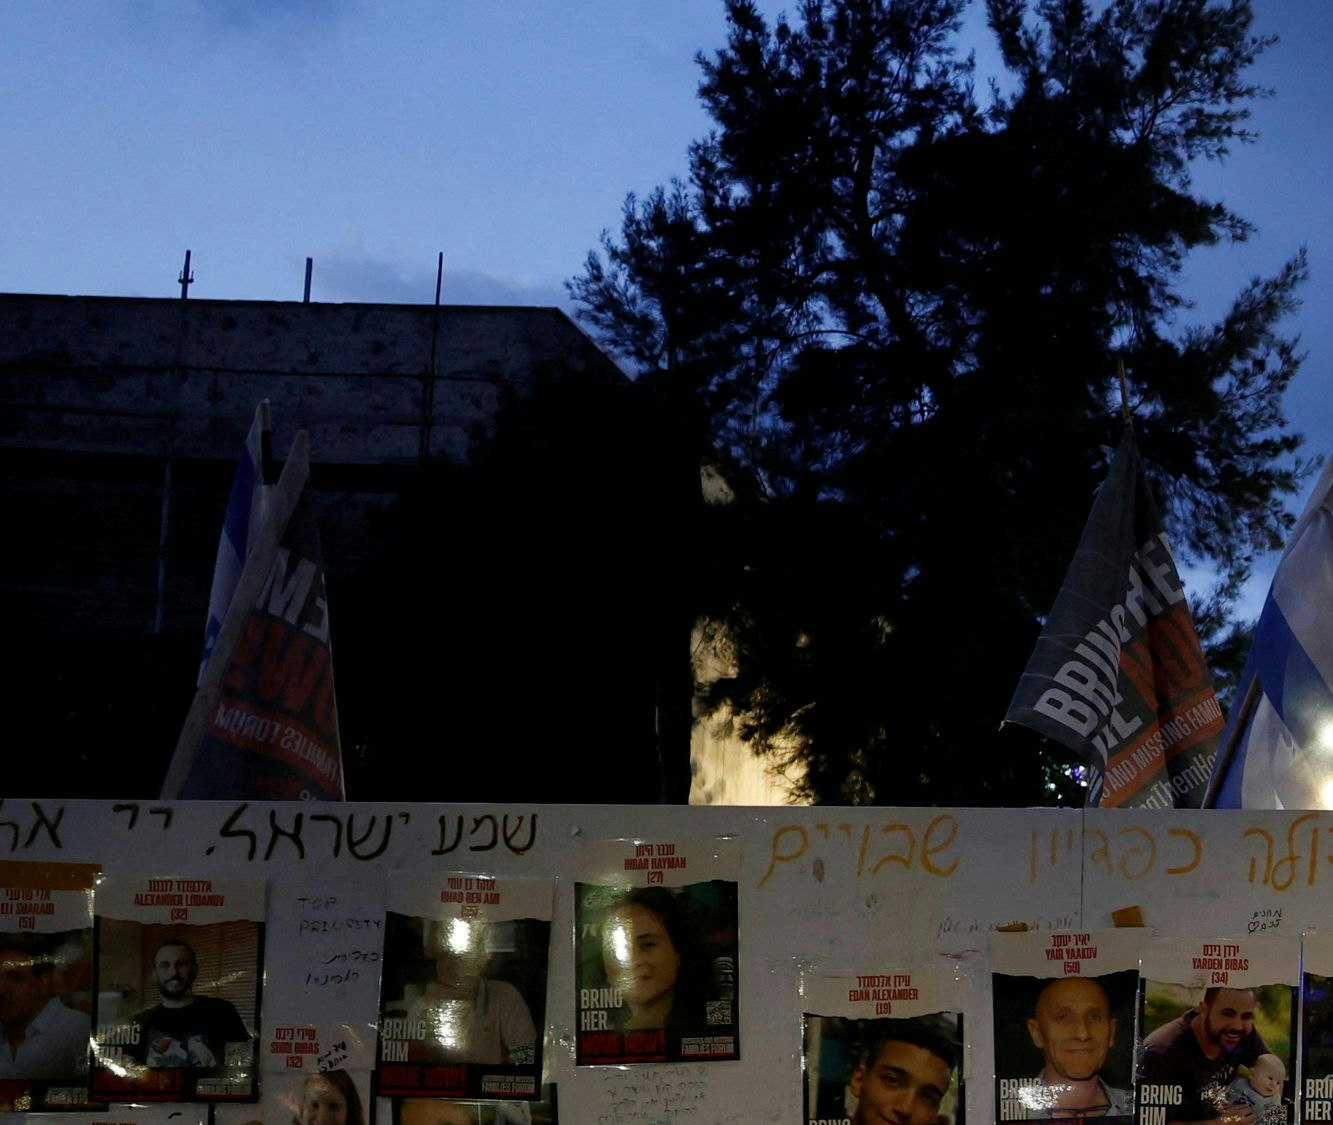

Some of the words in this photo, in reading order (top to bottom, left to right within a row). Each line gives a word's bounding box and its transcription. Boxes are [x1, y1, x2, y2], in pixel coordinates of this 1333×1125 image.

[1132, 716, 1192, 769] MISSING
[432, 813, 537, 855] שמע
[759, 815, 959, 887] שבויים
